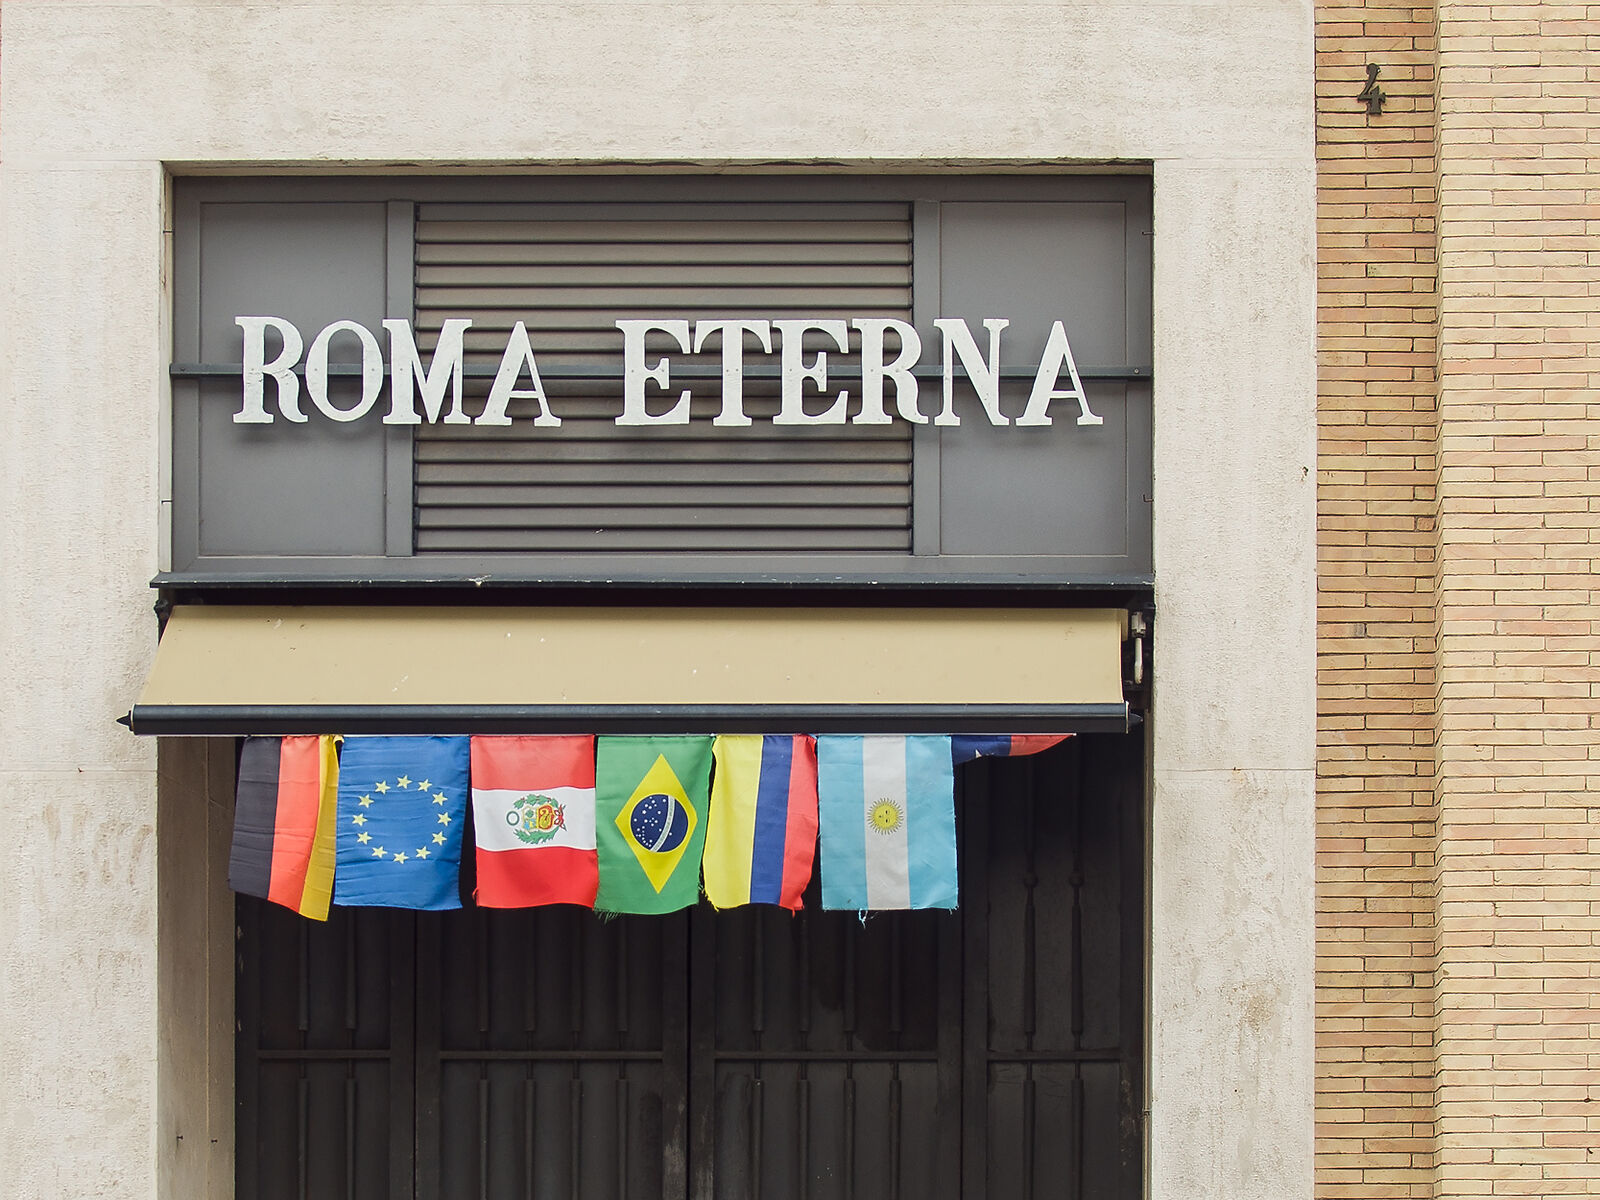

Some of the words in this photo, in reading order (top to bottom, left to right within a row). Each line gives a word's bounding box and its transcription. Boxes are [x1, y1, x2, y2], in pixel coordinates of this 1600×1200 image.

[1357, 63, 1386, 115] 4
[233, 316, 562, 427] ROMA
[615, 318, 1104, 427] ETERNA
